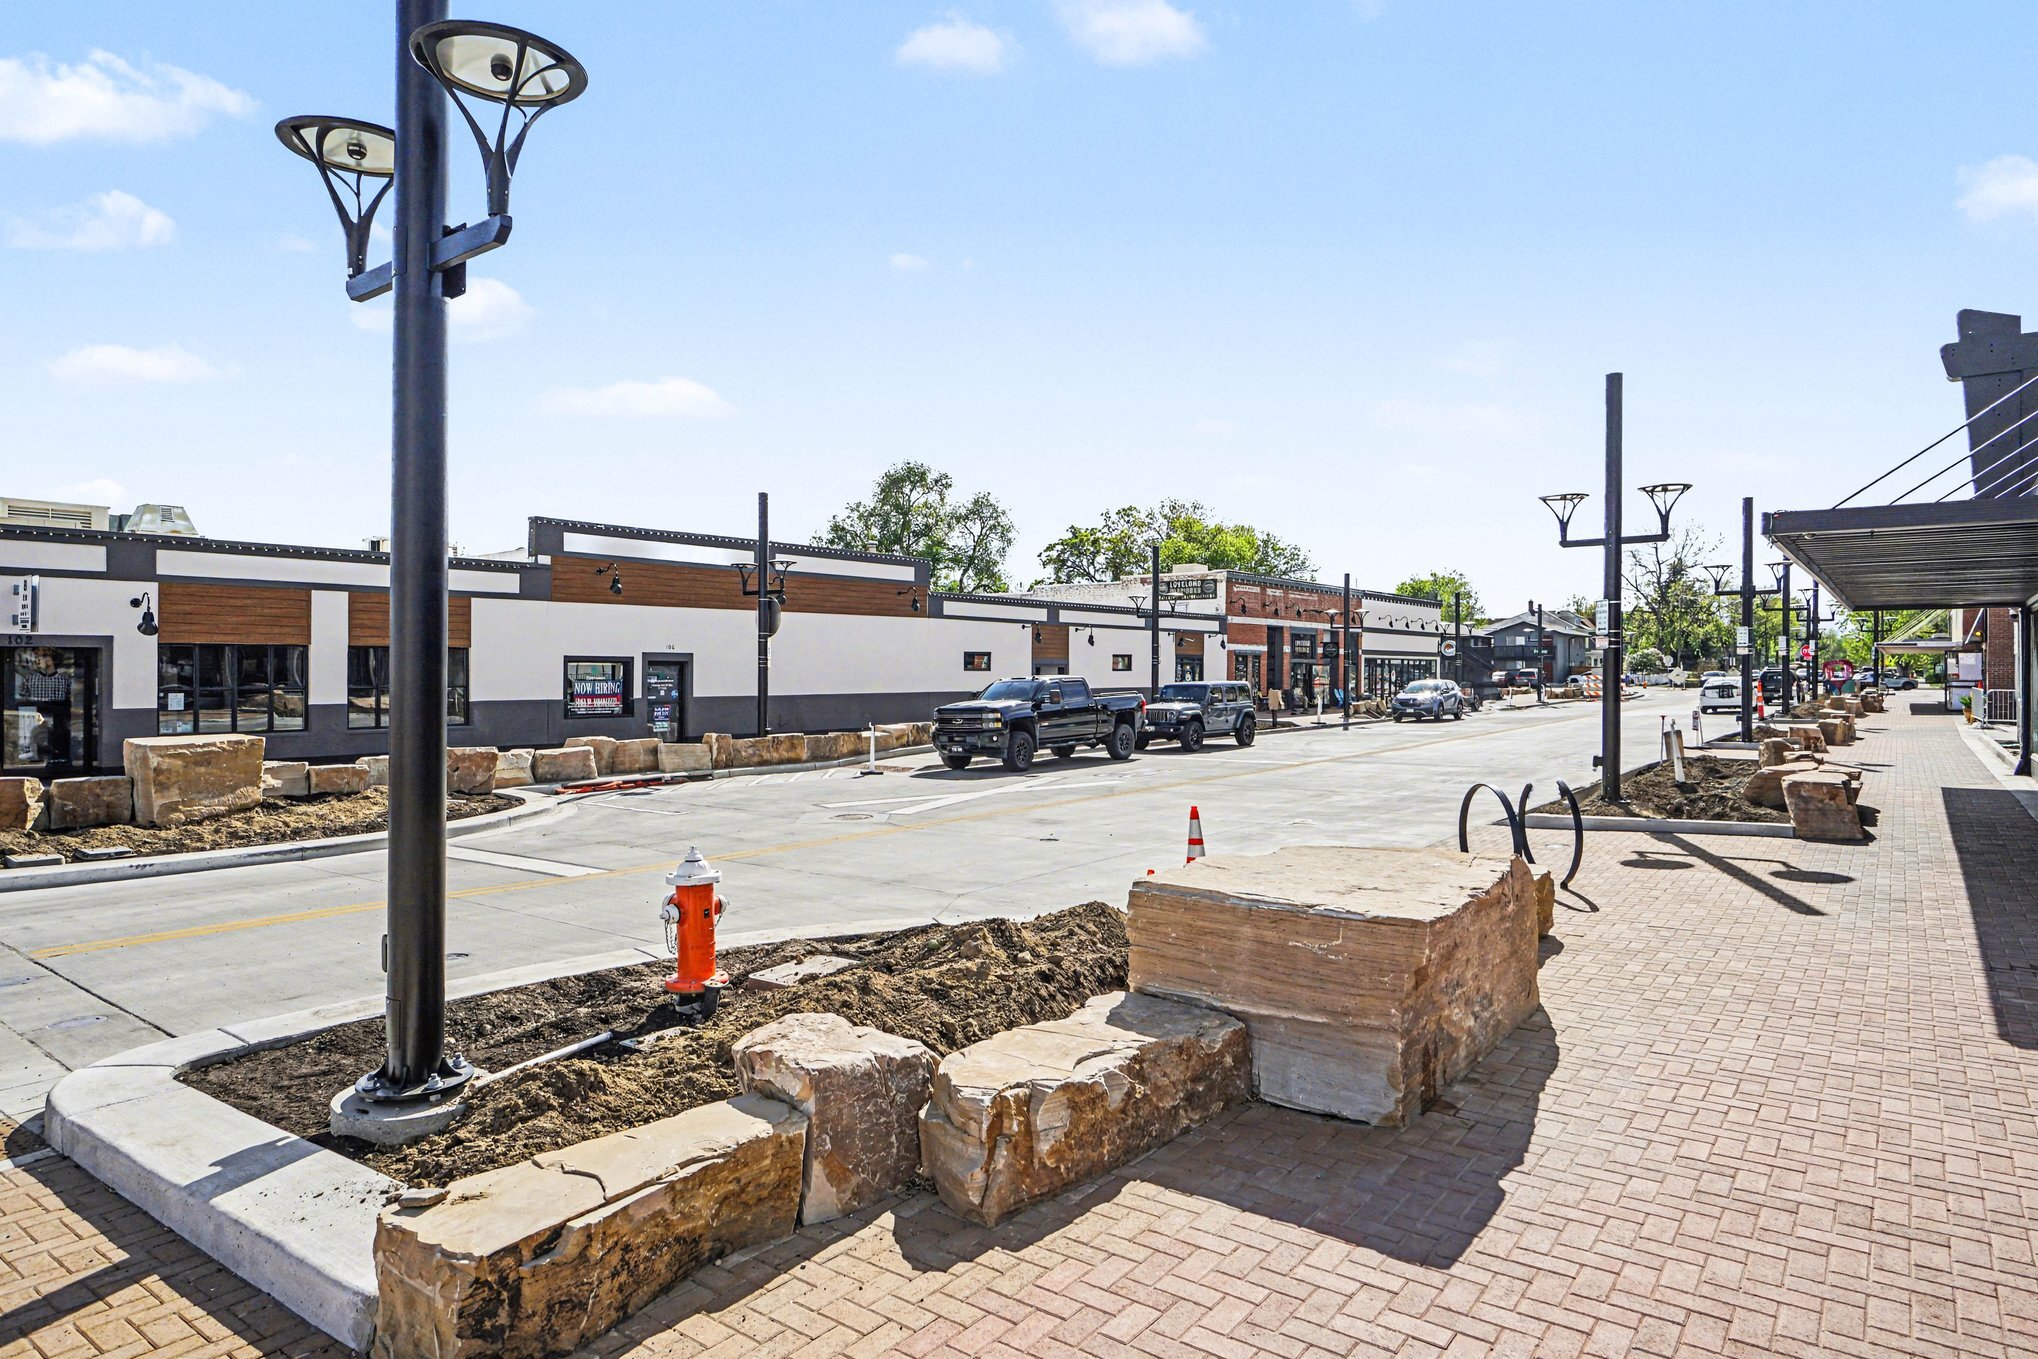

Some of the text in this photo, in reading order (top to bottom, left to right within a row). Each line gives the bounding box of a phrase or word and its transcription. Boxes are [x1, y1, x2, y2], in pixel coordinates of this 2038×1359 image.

[8, 635, 33, 645] 102
[574, 681, 621, 695] NOW HIRING
